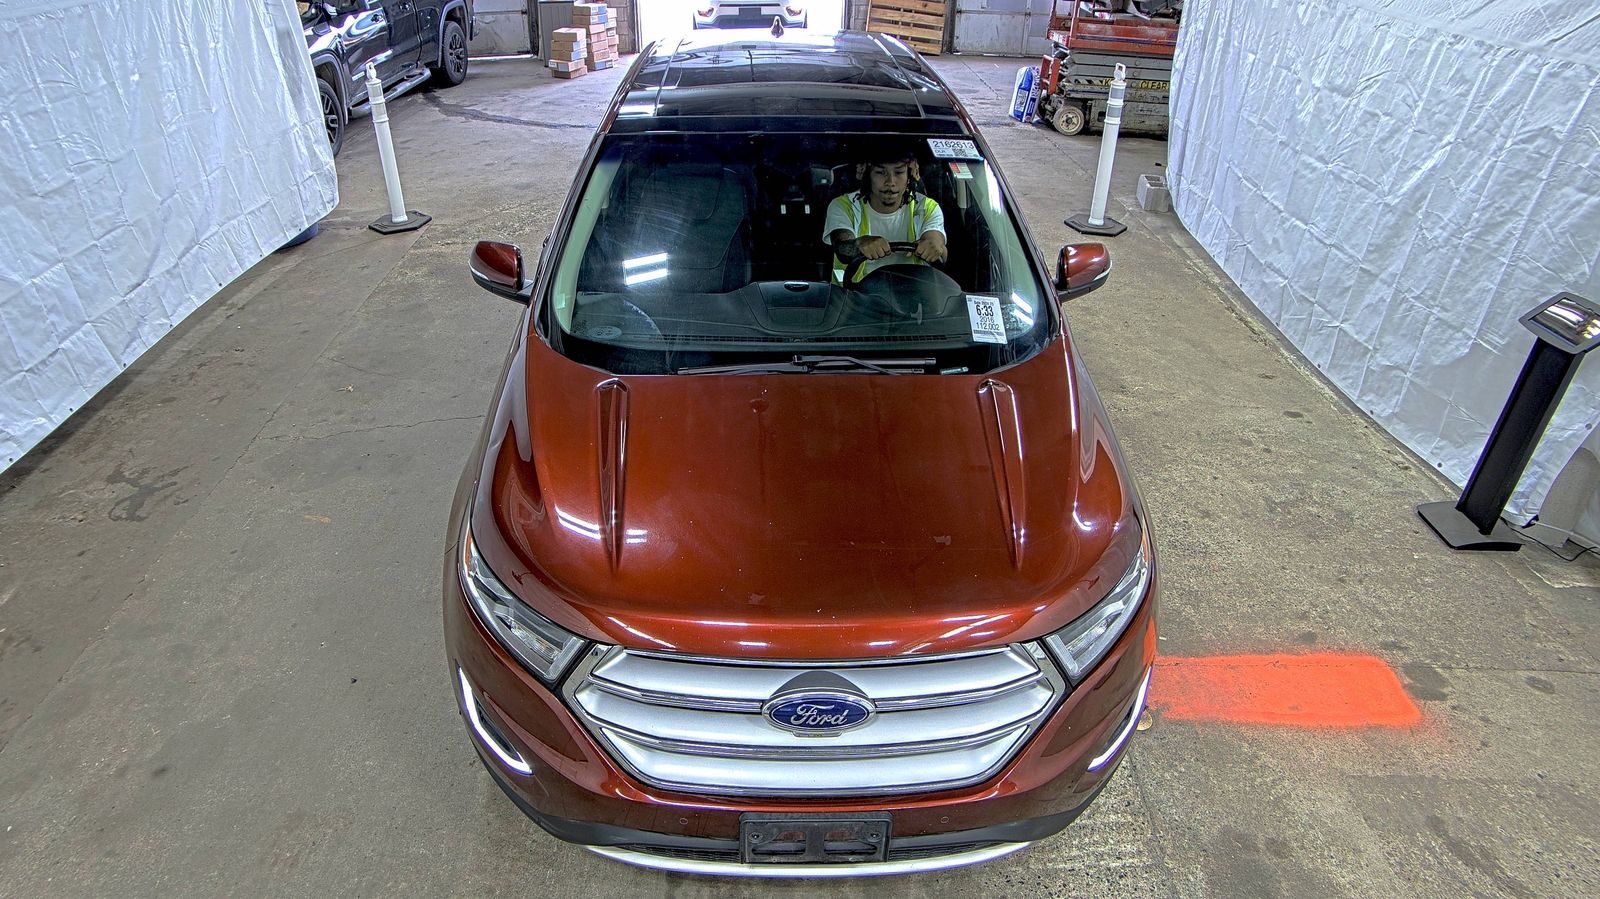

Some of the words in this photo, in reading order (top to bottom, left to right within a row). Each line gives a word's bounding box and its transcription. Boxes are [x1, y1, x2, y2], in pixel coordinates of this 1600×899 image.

[1140, 81, 1168, 90] CLEAR
[932, 140, 974, 149] 2162613
[976, 304, 994, 316] 6:33
[976, 322, 1000, 331] 112,002
[790, 704, 849, 725] Ford
